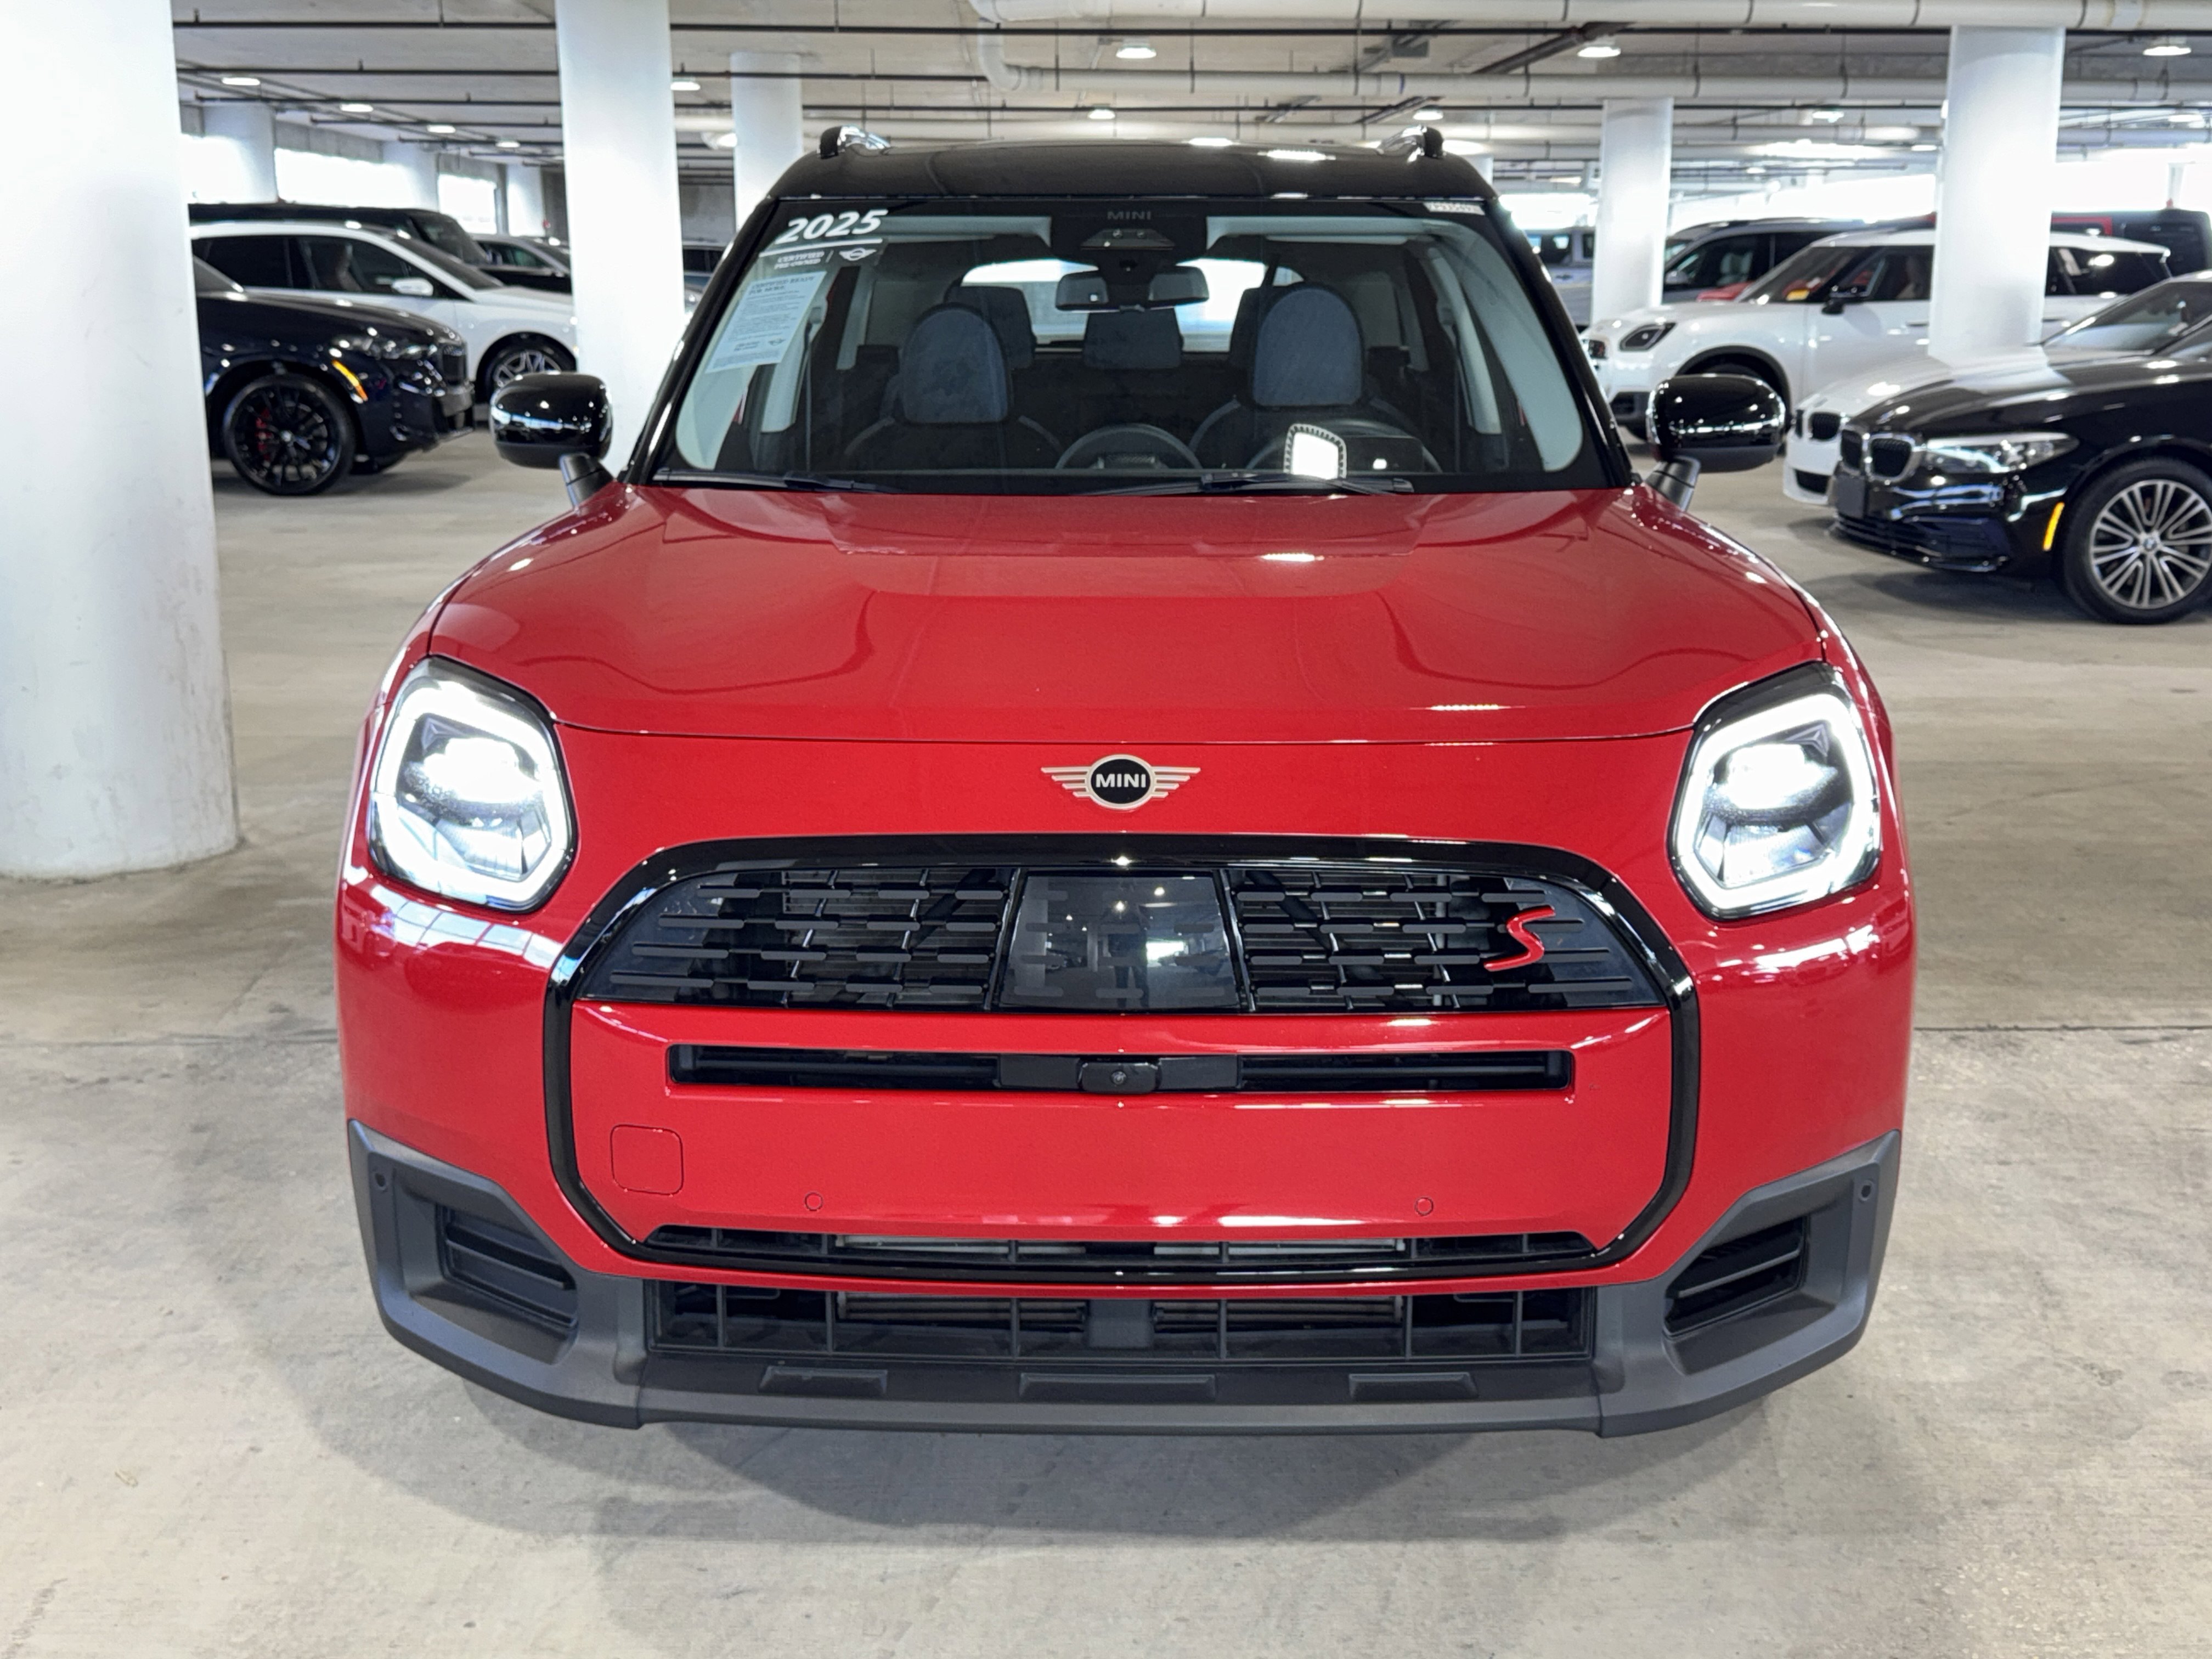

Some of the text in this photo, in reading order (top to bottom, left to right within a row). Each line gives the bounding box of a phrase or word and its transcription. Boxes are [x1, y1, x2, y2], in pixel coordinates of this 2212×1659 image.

[774, 209, 888, 244] 2025
[1107, 211, 1152, 220] MINI
[1096, 774, 1146, 788] MINI
[1483, 905, 1556, 972] S
